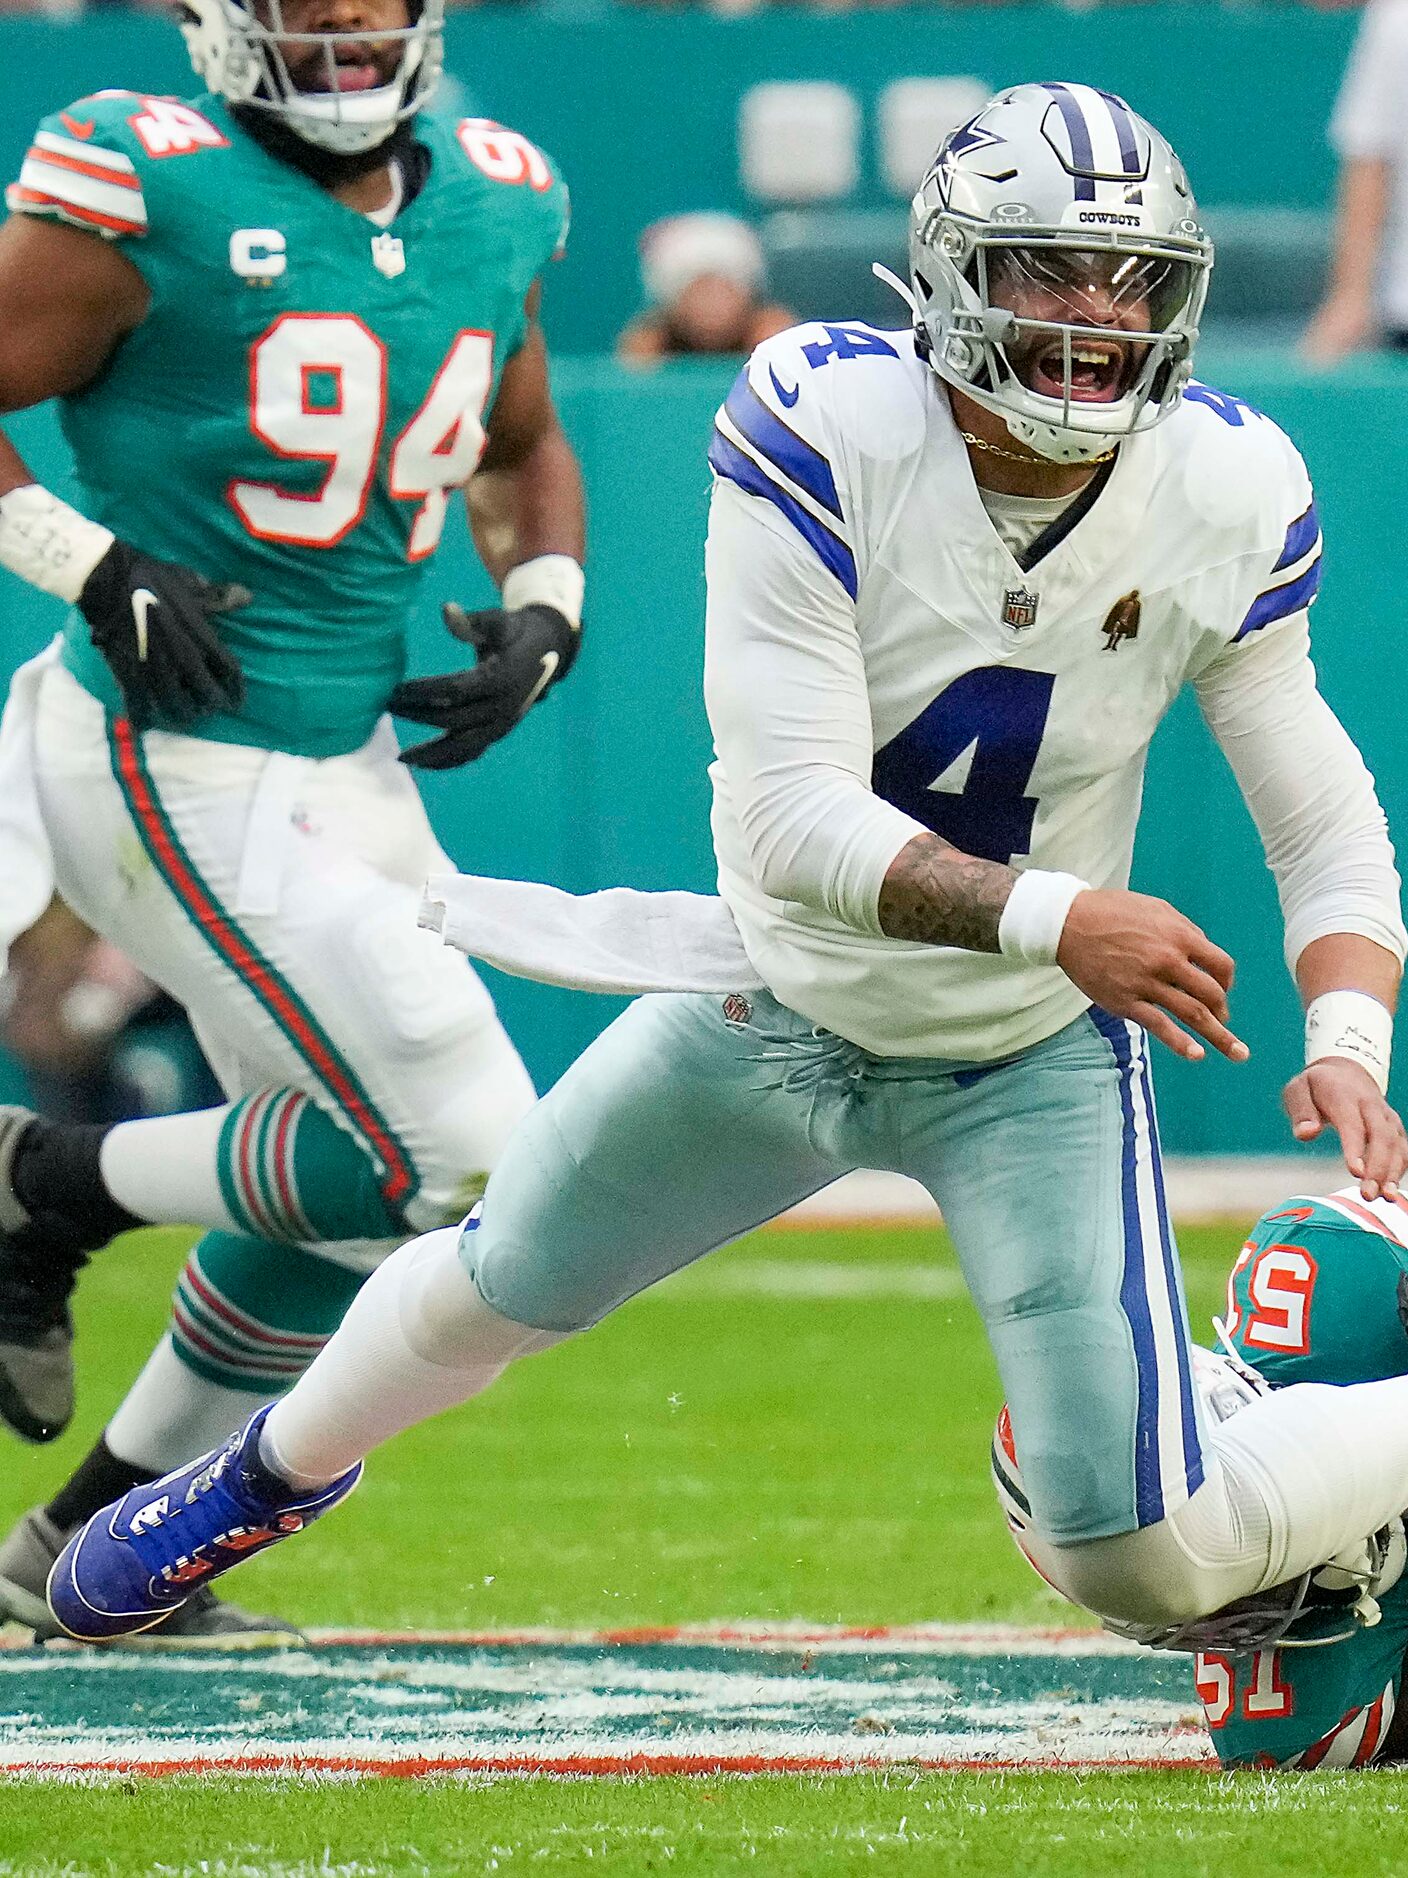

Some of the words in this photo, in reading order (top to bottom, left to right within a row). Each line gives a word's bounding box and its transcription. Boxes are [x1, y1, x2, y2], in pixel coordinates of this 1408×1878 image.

[1079, 211, 1140, 227] COWBOYS
[229, 228, 287, 277] C
[800, 326, 900, 369] 4
[226, 311, 494, 562] 94
[871, 664, 1056, 866] 4
[1195, 1651, 1292, 1730] 51
